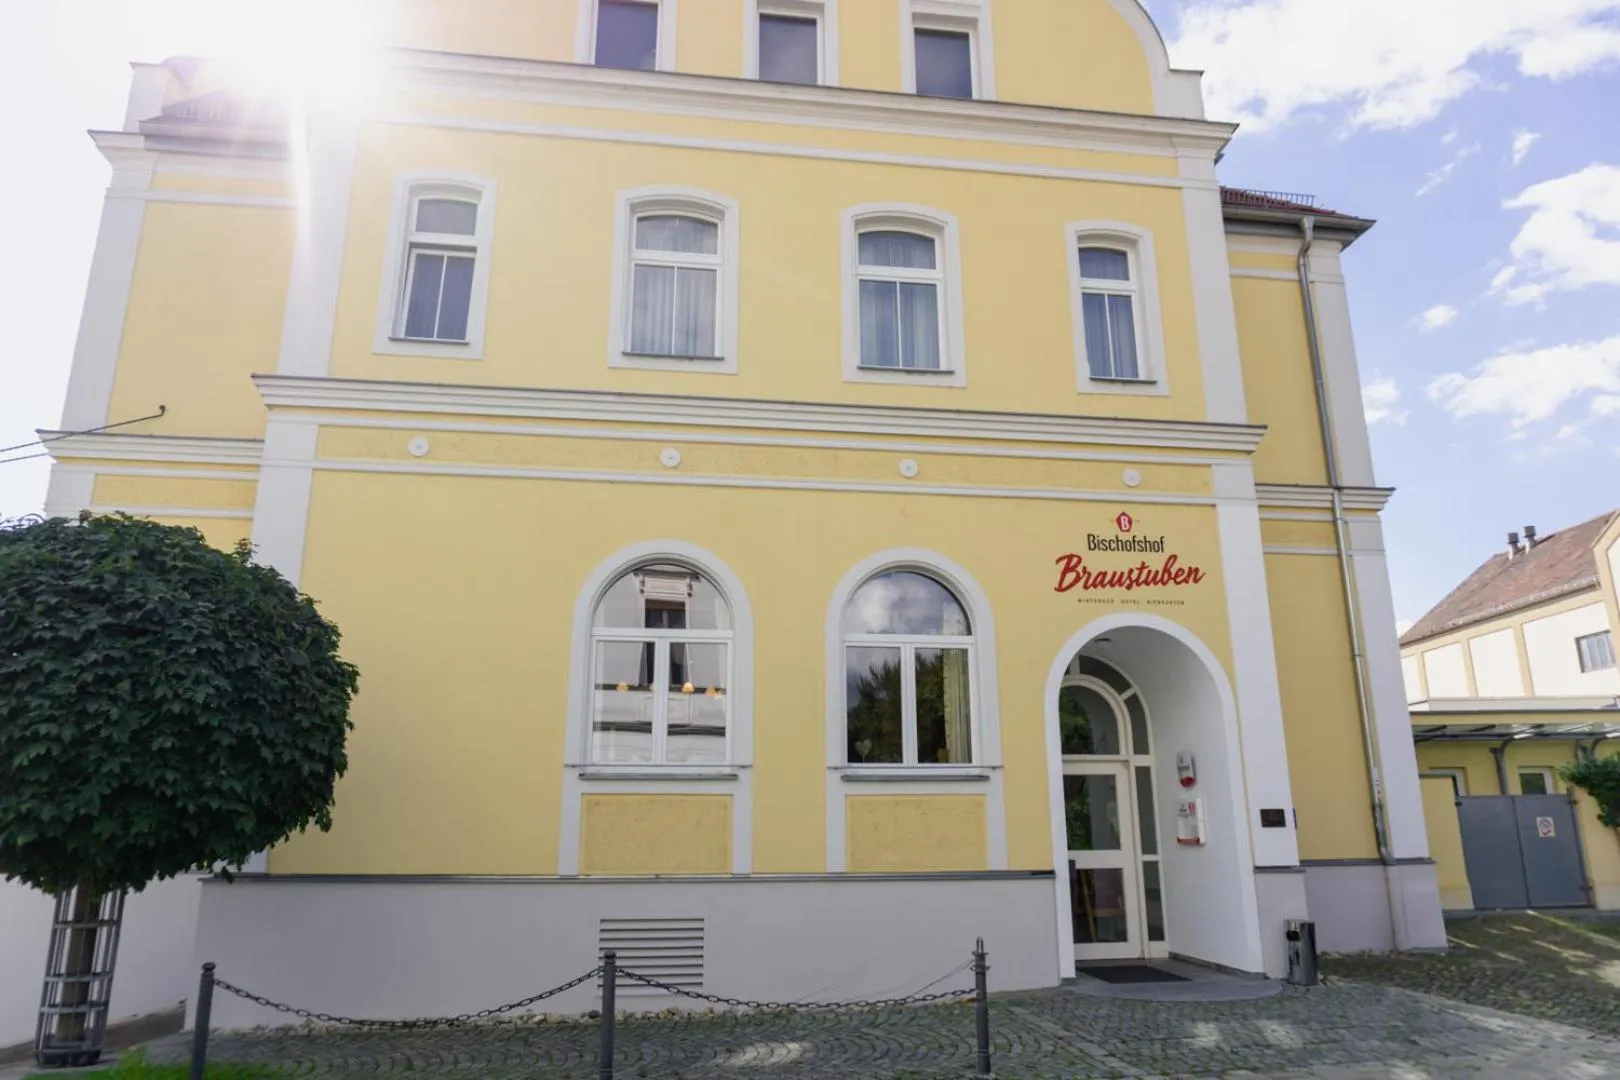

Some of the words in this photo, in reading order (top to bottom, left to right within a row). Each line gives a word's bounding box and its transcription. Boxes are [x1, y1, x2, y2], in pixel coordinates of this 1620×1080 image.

[1120, 515, 1129, 530] B
[1087, 533, 1165, 553] Bischofshof
[1054, 553, 1206, 592] Braustuben
